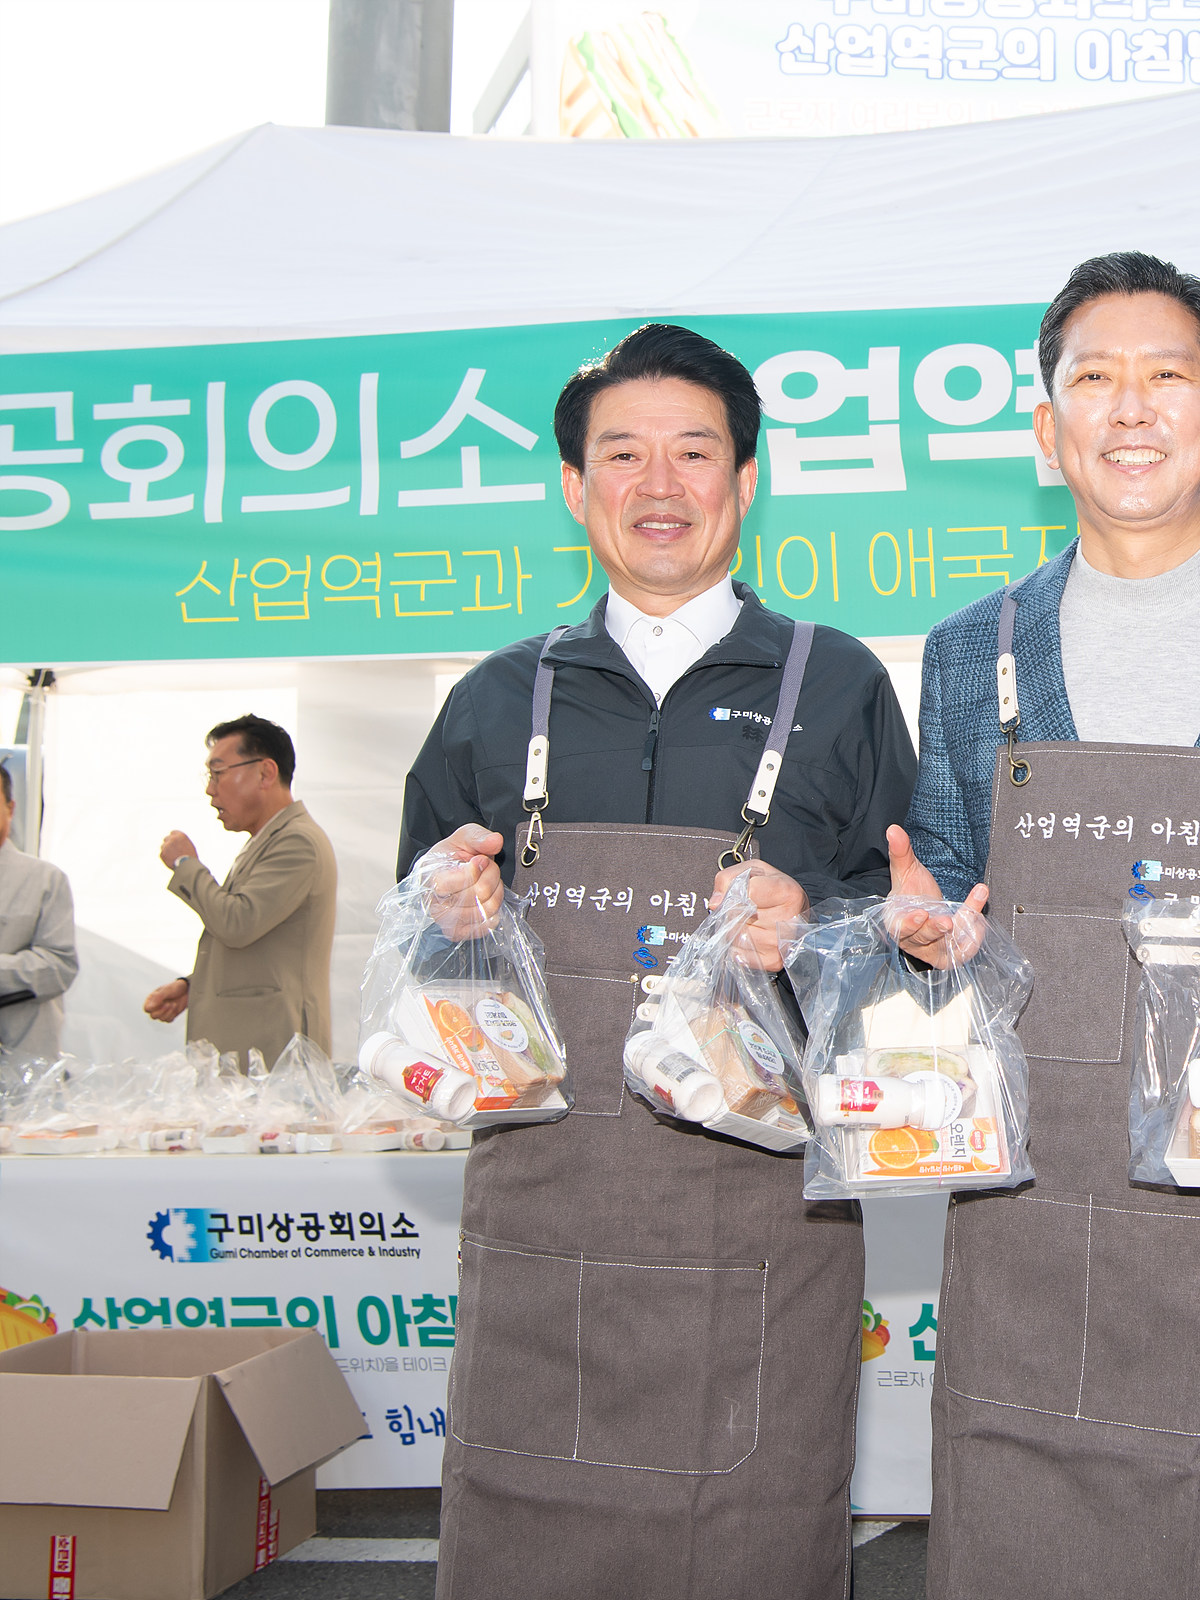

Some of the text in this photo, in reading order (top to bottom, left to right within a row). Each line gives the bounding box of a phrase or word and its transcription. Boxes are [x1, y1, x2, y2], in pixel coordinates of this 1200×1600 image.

[775, 22, 1057, 82] 산업역군의
[175, 545, 532, 624] 산업역군과
[731, 710, 803, 733] 구미상공소
[1014, 812, 1134, 843] 산업역군의
[525, 881, 711, 918] 산업역군의 아침
[950, 1122, 967, 1159] 오렌지
[207, 1211, 420, 1244] 구미상공회의소
[210, 1246, 421, 1260] Gumi Chamber of Commerce & Industry
[356, 1294, 458, 1348] 아침
[877, 1370, 925, 1388] 근로자
